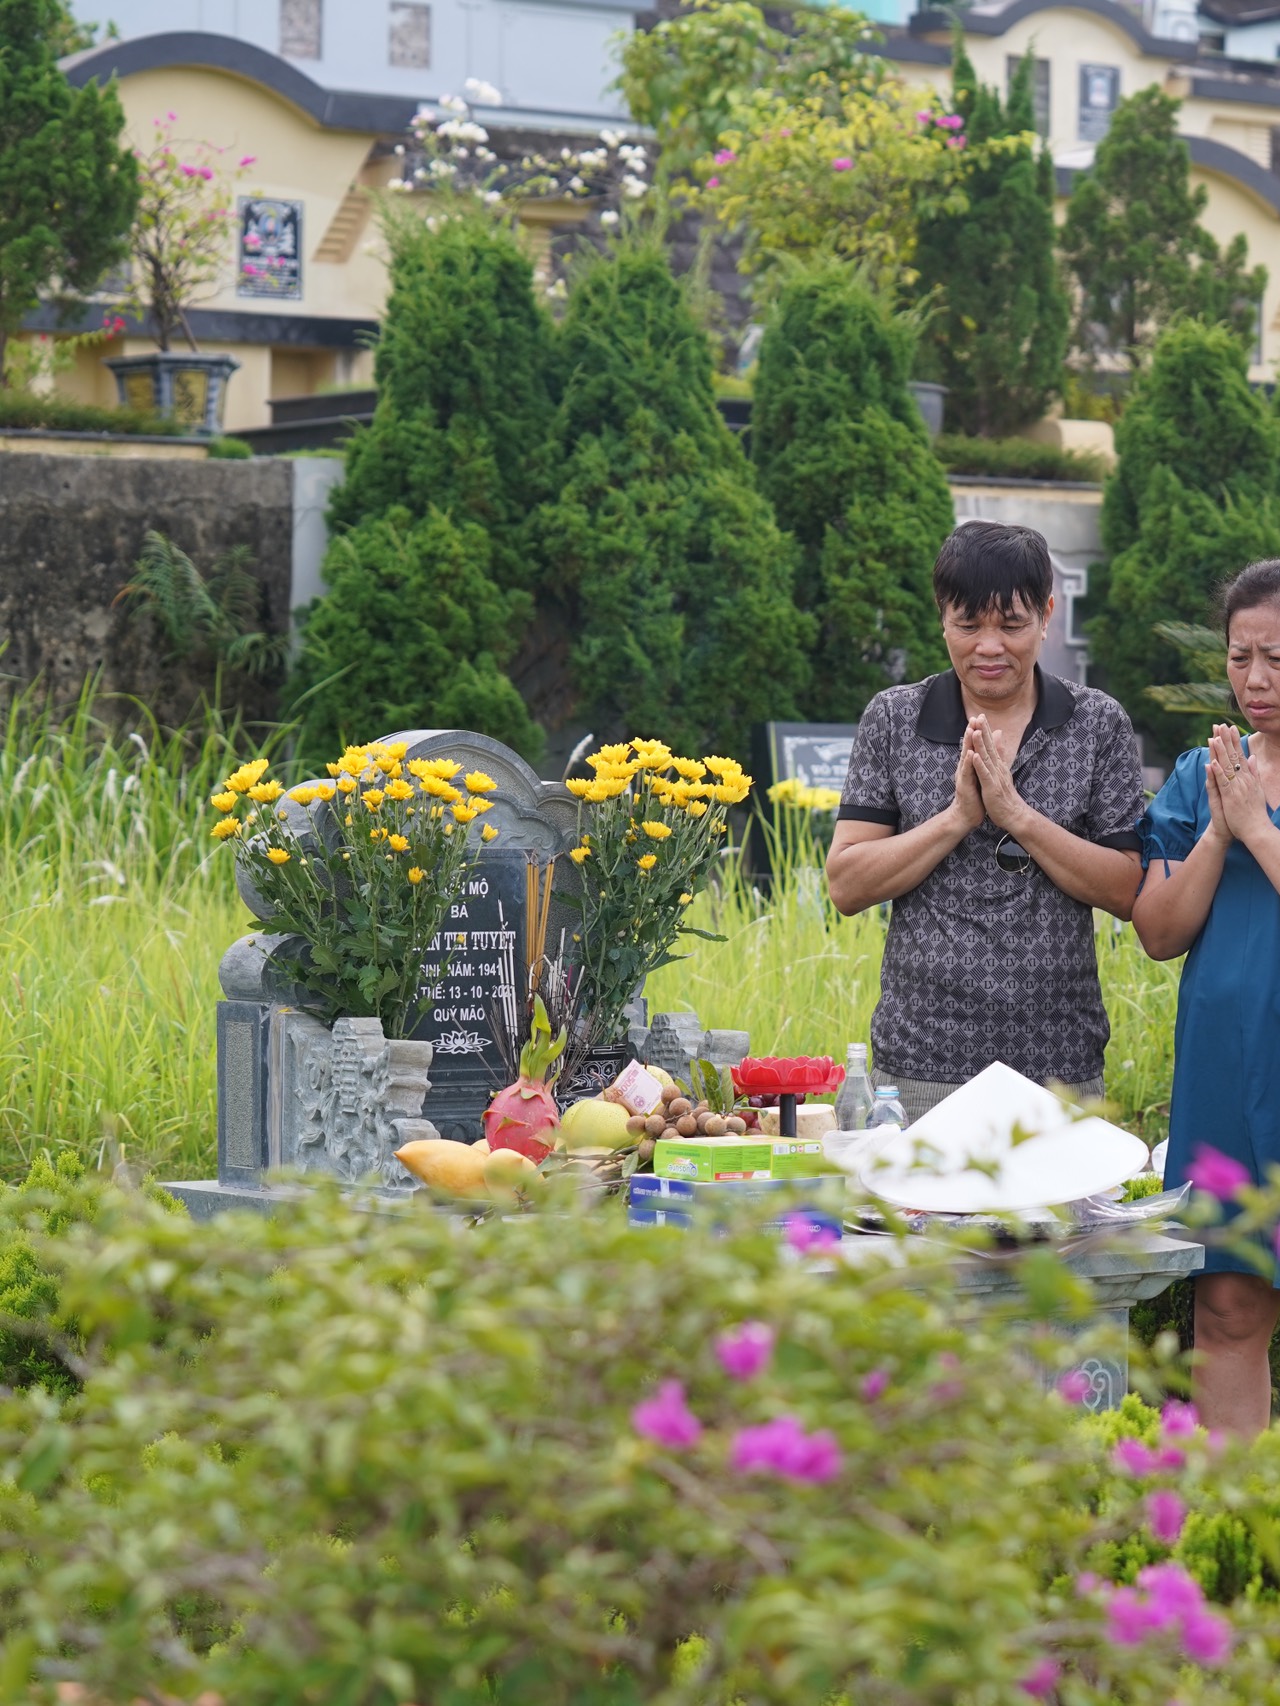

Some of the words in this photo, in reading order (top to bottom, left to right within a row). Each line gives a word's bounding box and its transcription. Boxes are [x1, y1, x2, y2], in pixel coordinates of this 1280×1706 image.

[469, 877, 489, 898] MỘ
[451, 901, 469, 918] BÀ
[478, 963, 502, 976] 1941
[449, 986, 461, 998] 13
[470, 985, 483, 998] 10
[433, 1004, 457, 1022] QUÝ
[460, 1004, 485, 1020] MÃO
